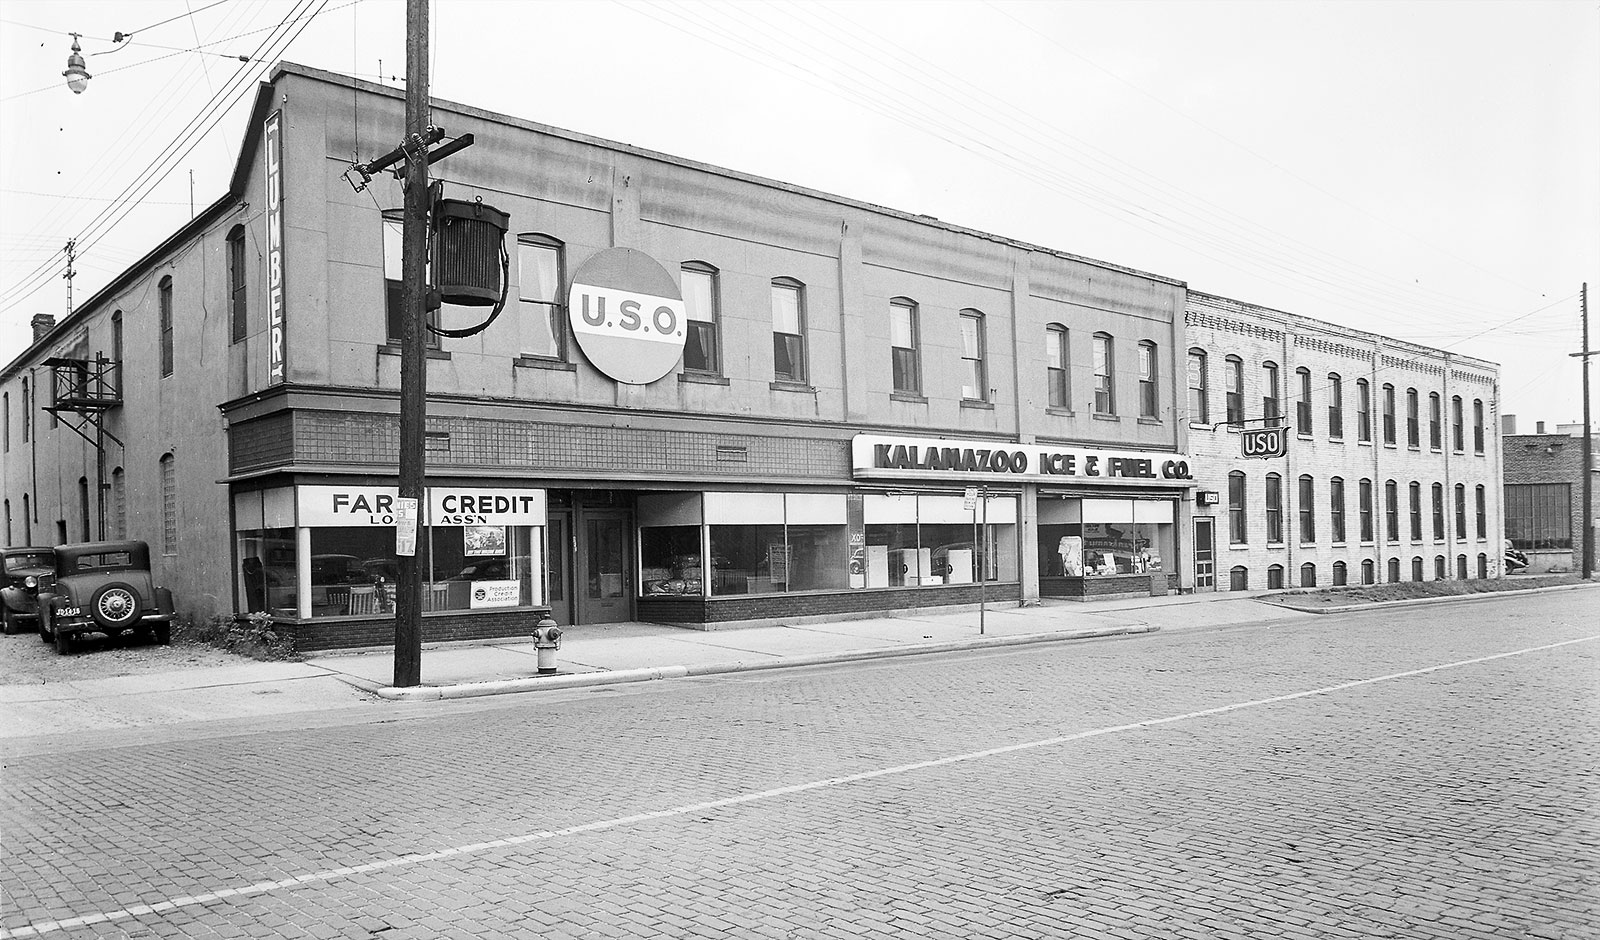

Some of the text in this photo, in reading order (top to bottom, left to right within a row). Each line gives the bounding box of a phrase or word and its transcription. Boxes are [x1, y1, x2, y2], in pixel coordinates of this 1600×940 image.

[267, 138, 283, 363] LUMBER
[581, 293, 682, 337] U.S.O.
[873, 443, 1028, 474] KALAMAZOO
[1039, 452, 1075, 476] ICE
[1107, 457, 1157, 478] FUEL
[1161, 460, 1193, 480] CO.
[1245, 432, 1278, 454] USO
[333, 493, 534, 514] FAR CREDIT
